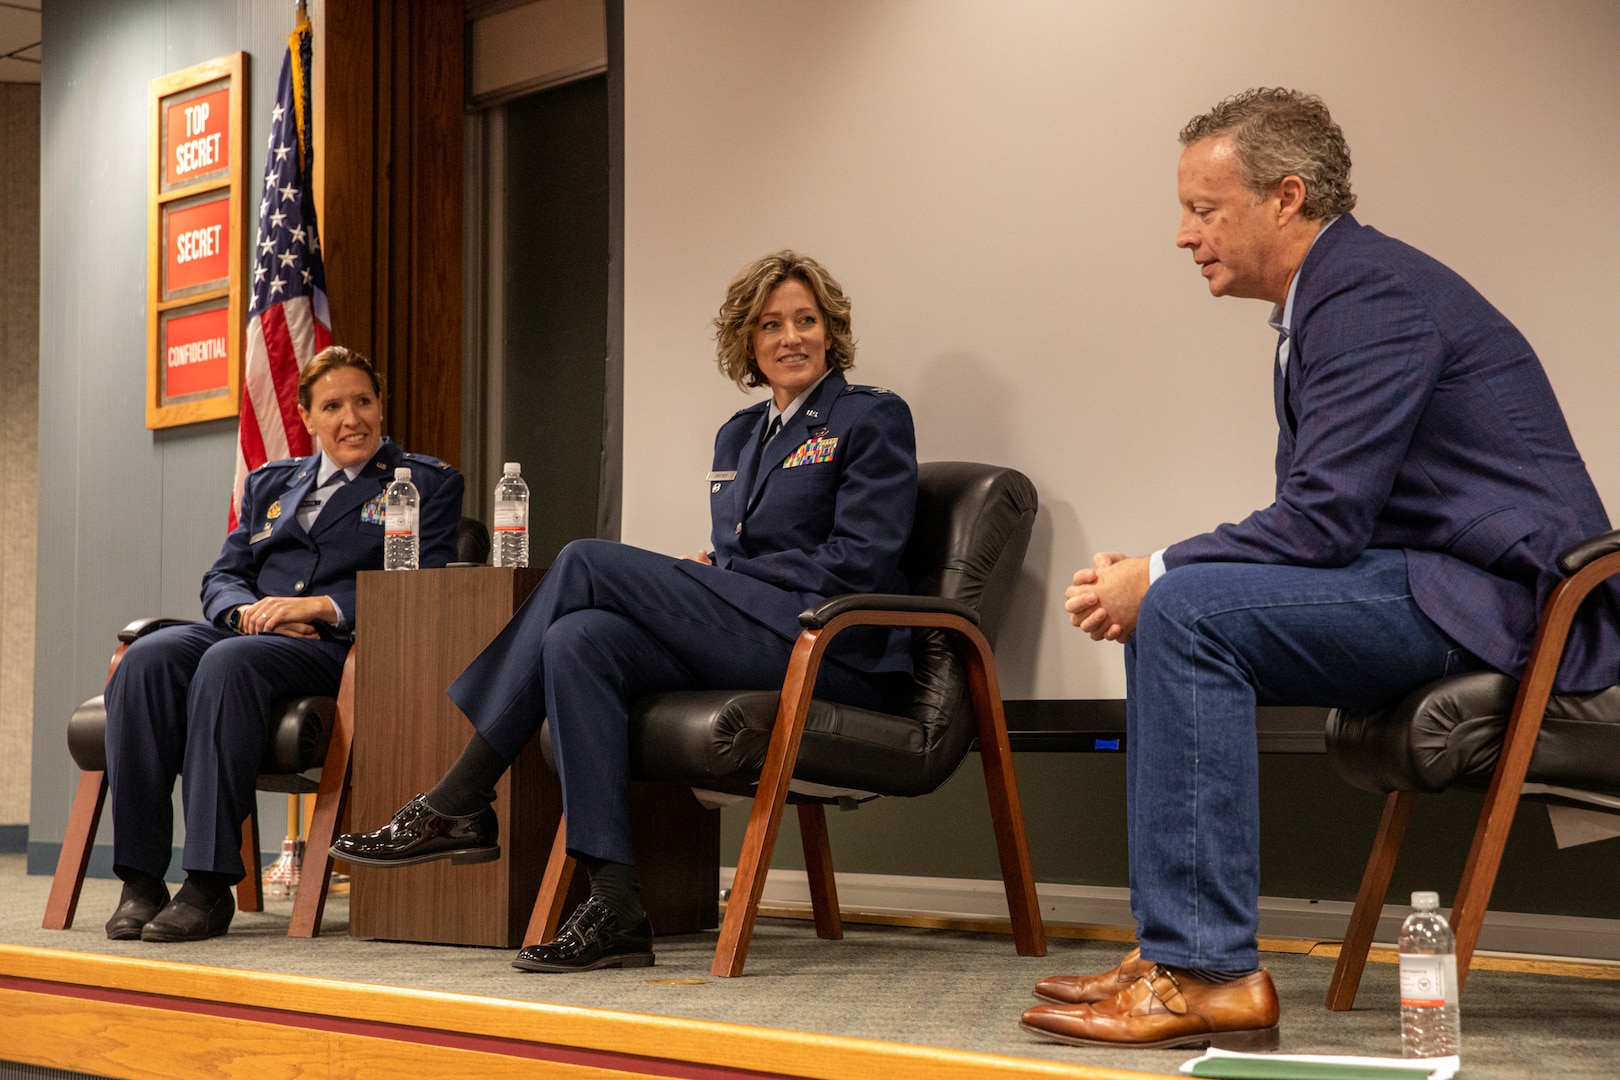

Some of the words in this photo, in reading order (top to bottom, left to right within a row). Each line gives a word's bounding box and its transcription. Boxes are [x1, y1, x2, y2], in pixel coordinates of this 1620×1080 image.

[184, 102, 210, 138] TOP
[175, 132, 222, 175] SECRET
[177, 224, 222, 264] SECRET
[168, 336, 228, 368] CONFIDENTIAL
